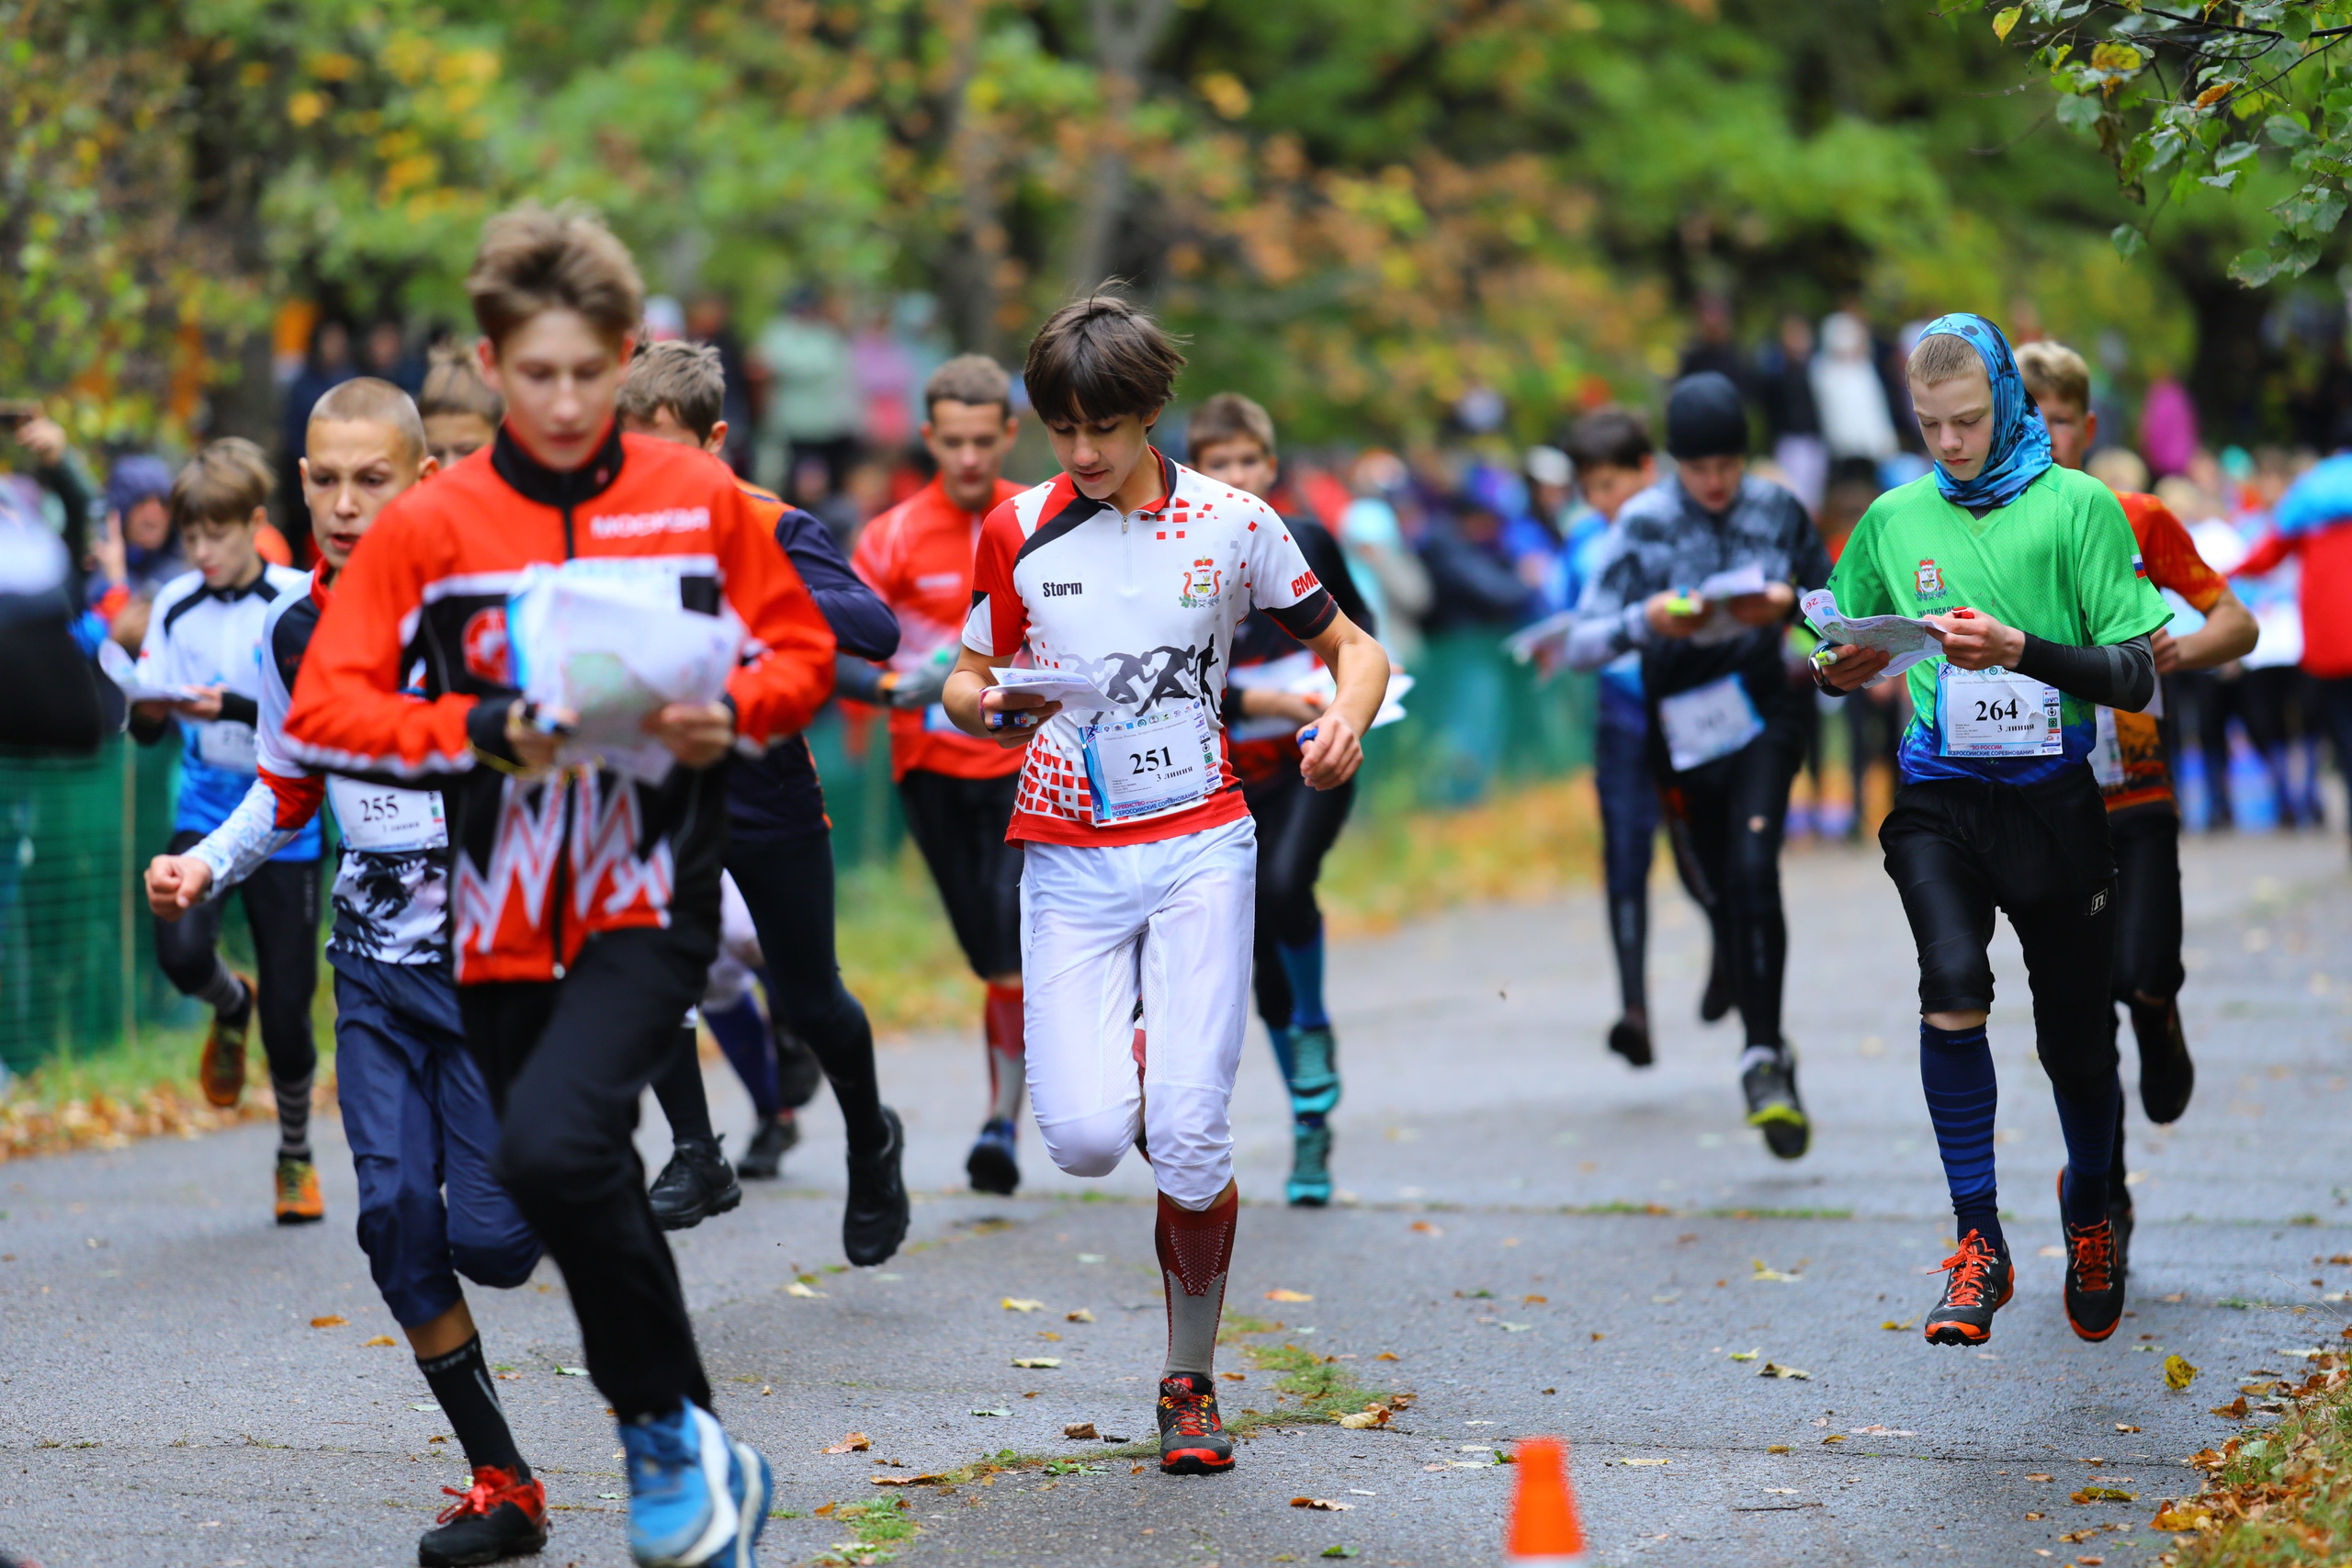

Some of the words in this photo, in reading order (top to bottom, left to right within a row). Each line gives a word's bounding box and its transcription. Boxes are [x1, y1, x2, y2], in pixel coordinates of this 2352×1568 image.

[1043, 581, 1083, 598] Storm
[1975, 698, 2018, 722] 264
[2006, 724, 2035, 732] линия
[1129, 746, 1173, 775] 251
[1156, 773, 1161, 782] 3
[1164, 766, 1193, 780] линия
[360, 794, 400, 822] 255
[1111, 799, 1146, 811] ПЕРВЕНСТВО
[1112, 804, 1158, 818] ВСЕРОССИЙСКИЕ
